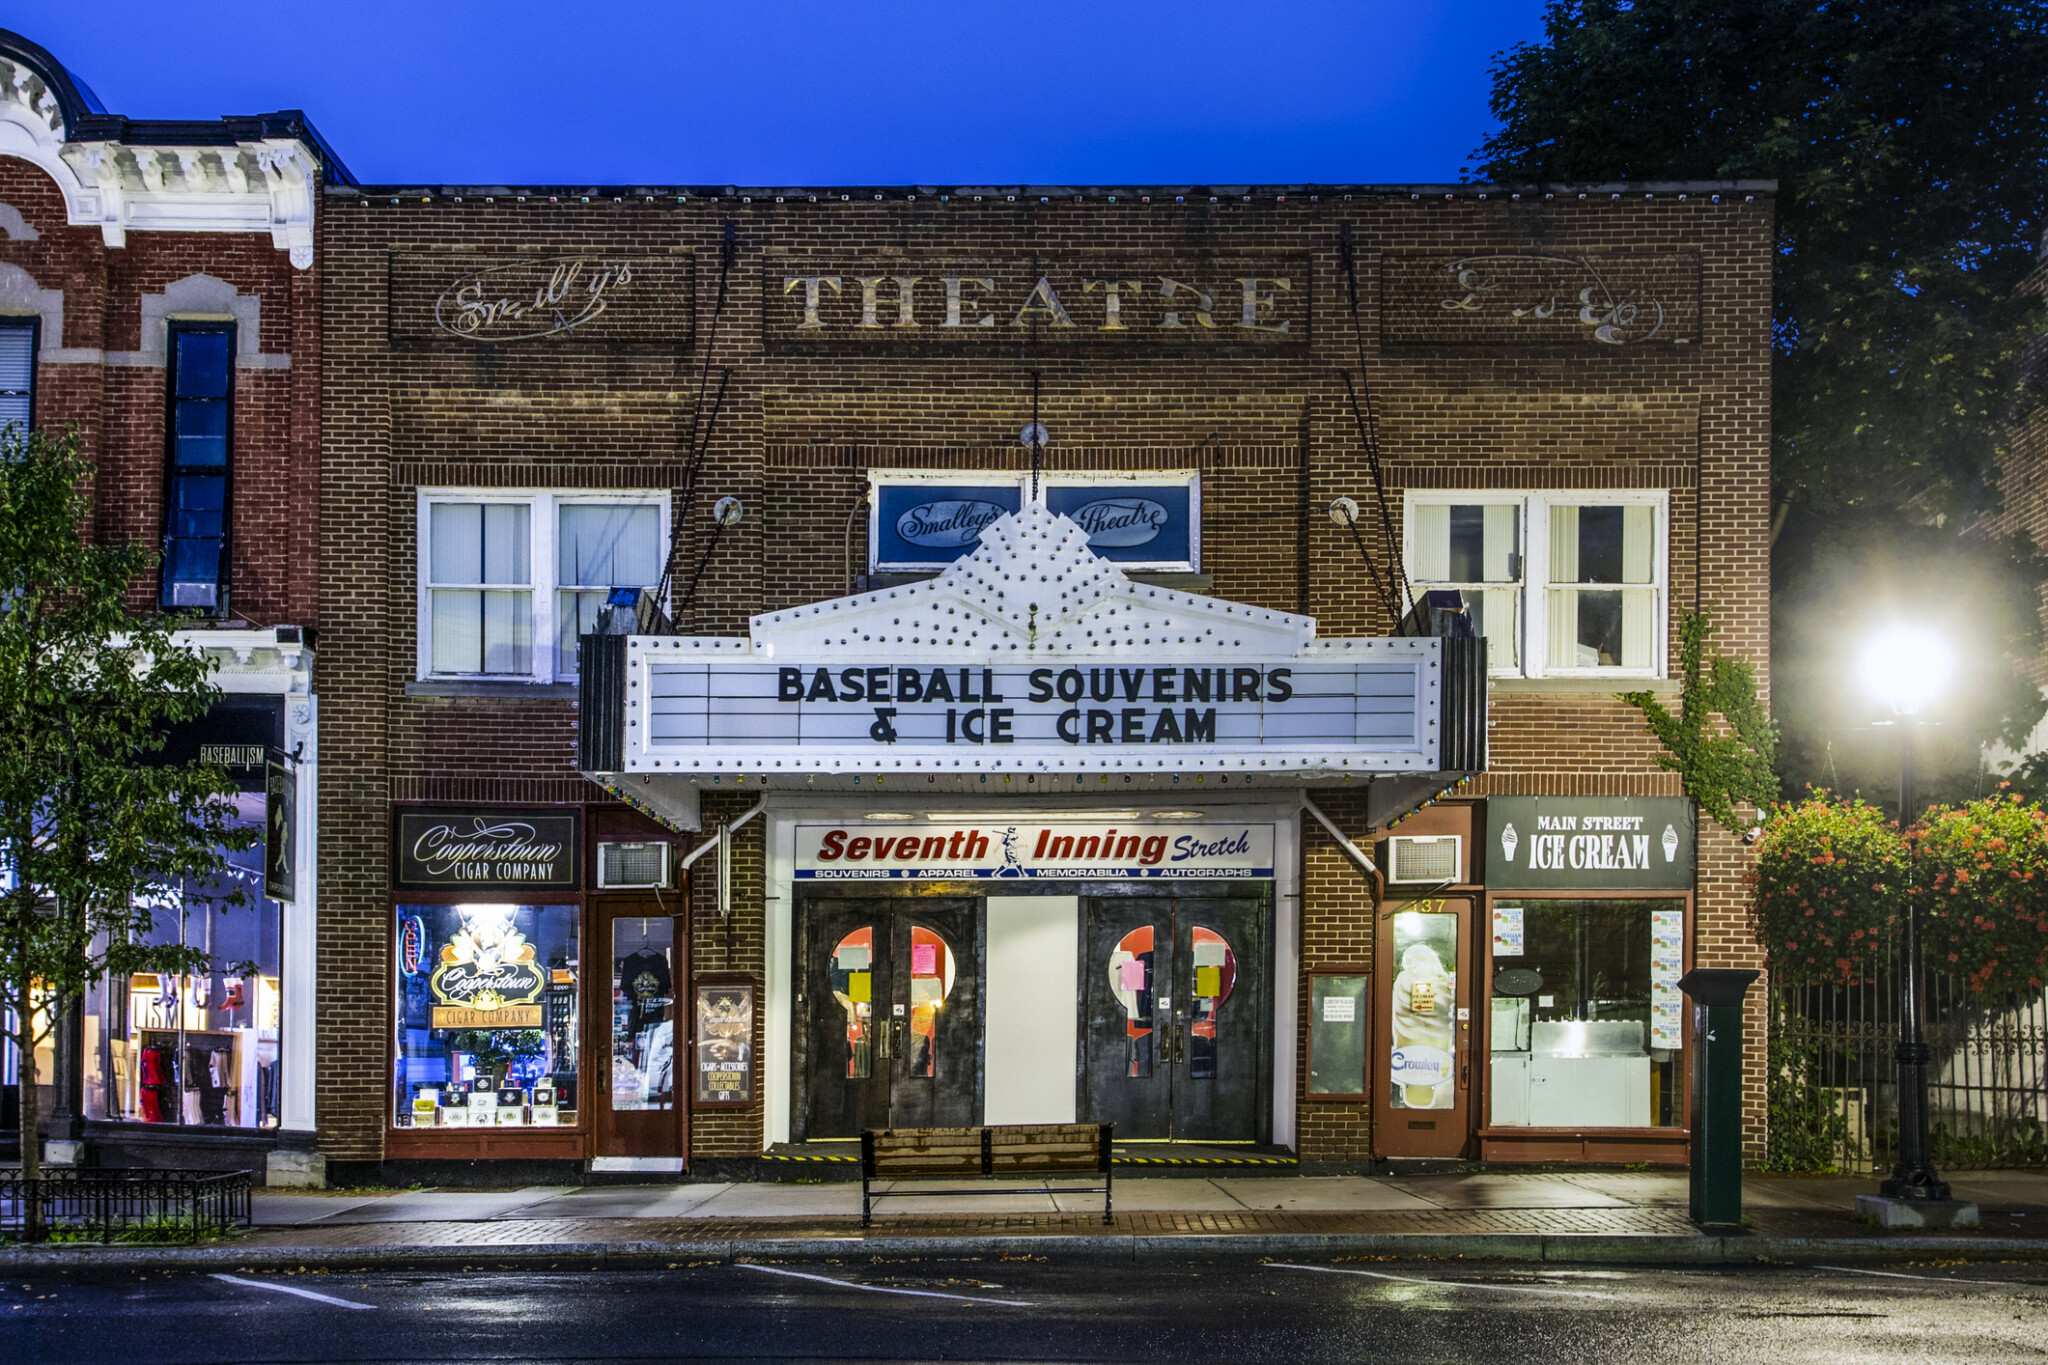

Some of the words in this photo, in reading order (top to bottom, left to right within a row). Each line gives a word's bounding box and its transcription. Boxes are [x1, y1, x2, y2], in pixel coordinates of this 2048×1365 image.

[784, 276, 1290, 334] THEATRE
[901, 502, 999, 542] Smalley's
[1076, 502, 1161, 534] Theatre
[778, 666, 1002, 703] BASEBALL
[1028, 667, 1293, 703] SOUVENIRS
[869, 707, 897, 743] &
[946, 708, 1014, 743] ICE
[1056, 708, 1216, 744] CREAM
[1537, 816, 1577, 830] MAIN
[1582, 816, 1643, 830] STREET
[414, 818, 561, 874] Cooperstown
[818, 829, 989, 861] Seventh
[1033, 828, 1169, 865] Inning
[1170, 829, 1250, 862] Stretch
[1529, 835, 1565, 869] ICE
[1569, 835, 1650, 869] CREAM
[454, 862, 489, 880] CIGAR
[496, 862, 553, 880] COMPANY
[815, 870, 890, 878] SOUVENIRS
[917, 870, 979, 878] APPAREL
[1036, 869, 1129, 878] MEMORABILIA
[1161, 869, 1252, 878] AUTOGRAPHS
[1410, 899, 1446, 913] 137
[404, 919, 418, 972] OPEN
[441, 964, 537, 999] Cooperstown
[446, 1010, 475, 1024] CIGAR
[482, 1009, 530, 1023] COMPANY
[1391, 1051, 1440, 1073] Crowley
